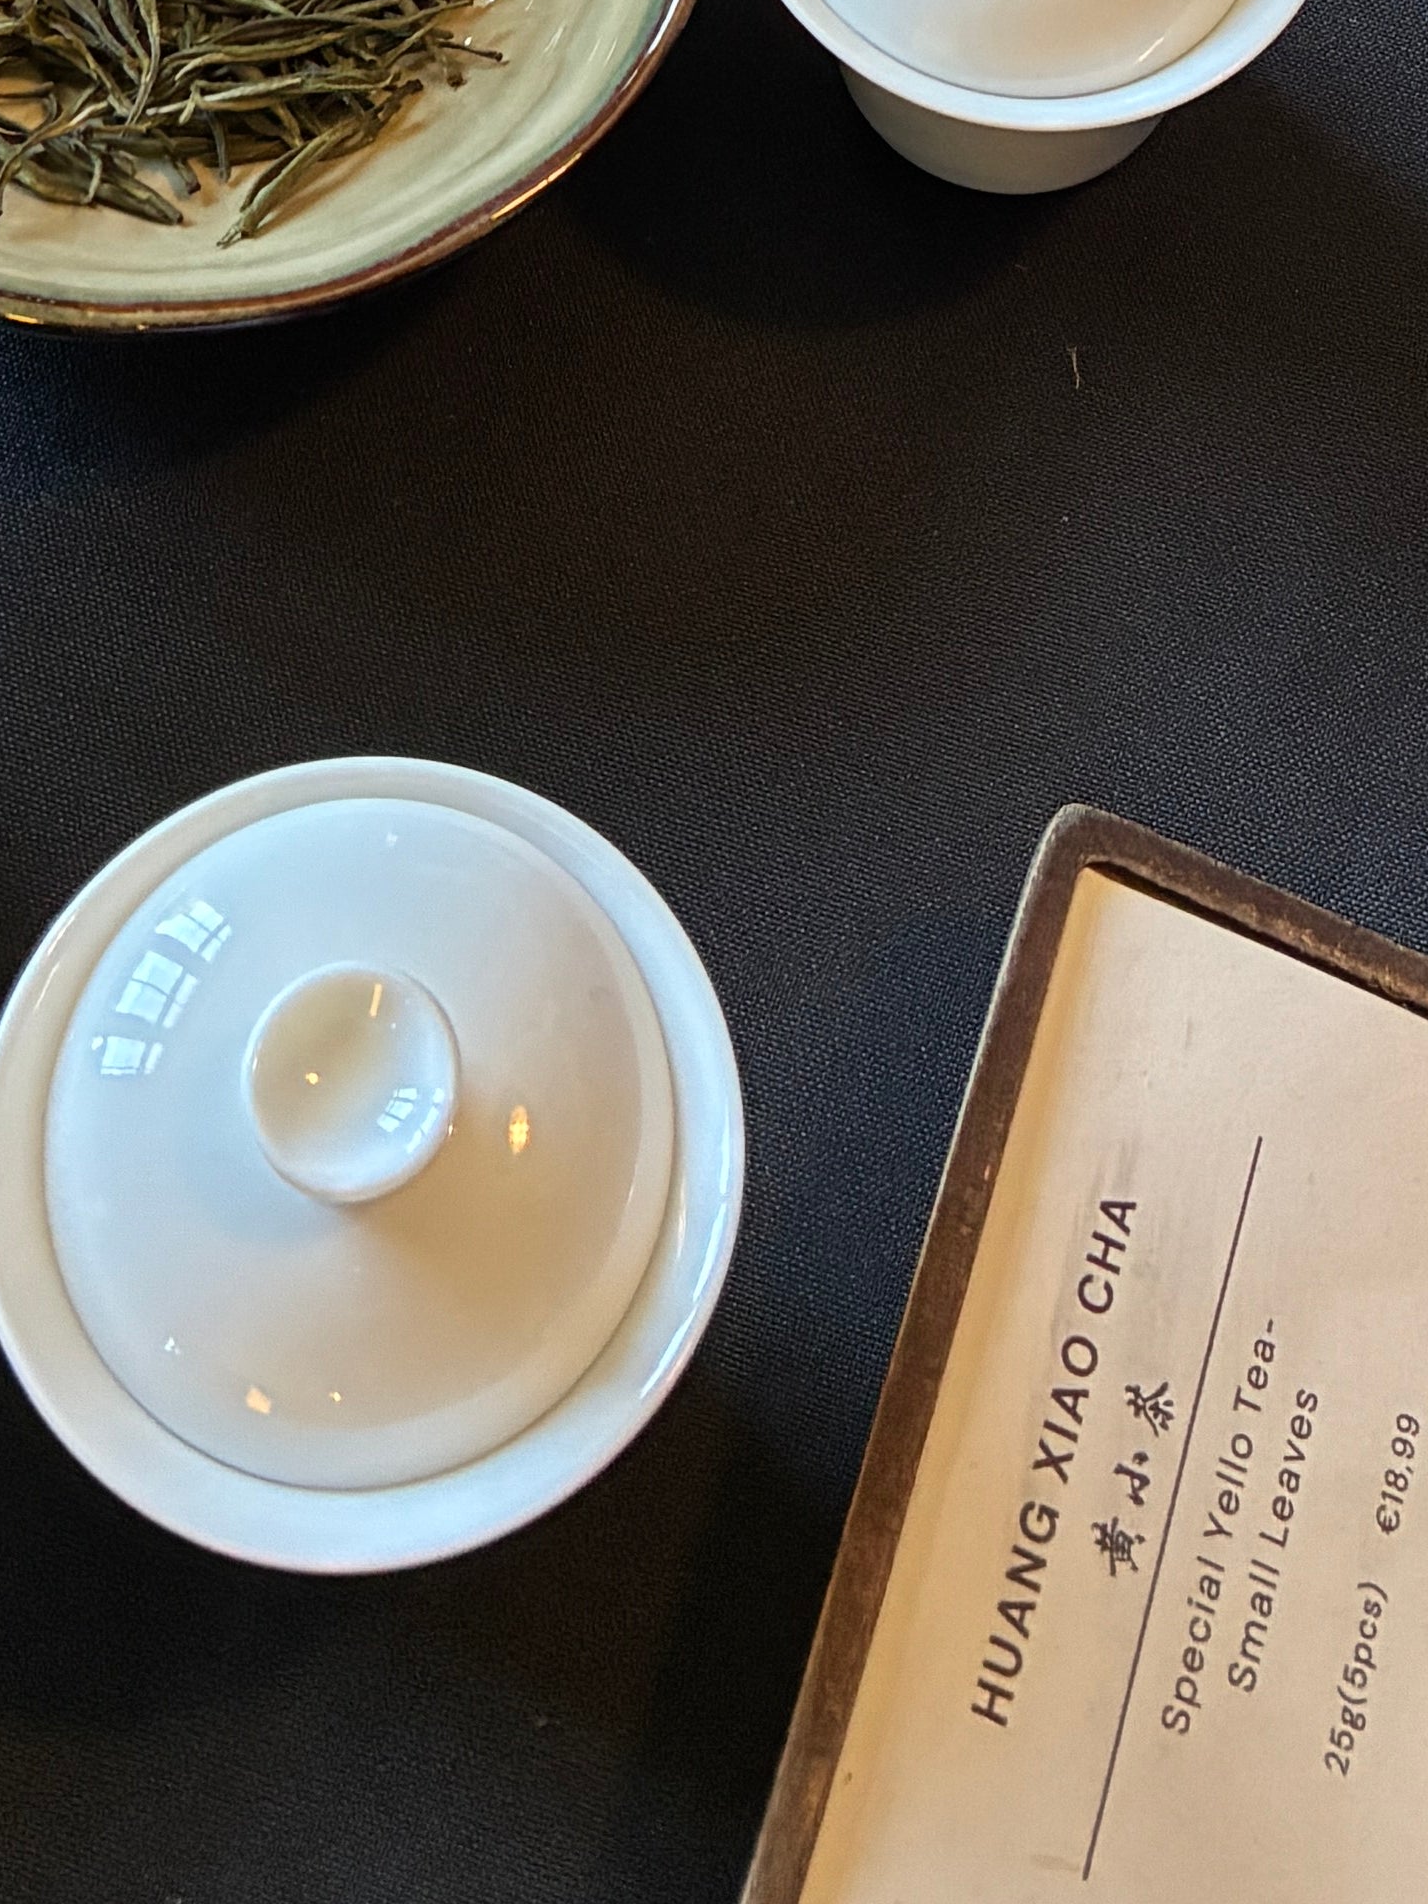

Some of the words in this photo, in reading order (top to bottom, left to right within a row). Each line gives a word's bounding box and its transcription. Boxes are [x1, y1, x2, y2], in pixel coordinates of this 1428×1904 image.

[969, 1499, 1060, 1726] HUANG
[1030, 1334, 1099, 1484] XIAO
[1075, 1199, 1137, 1315] CHA
[1090, 1381, 1174, 1577] 黄小茶
[1159, 1554, 1226, 1736] Special
[1201, 1432, 1254, 1538] Yello
[1231, 1318, 1276, 1413] Tea-
[1226, 1557, 1280, 1693] Small
[1257, 1388, 1318, 1549] Leaves
[1322, 1580, 1388, 1776] 25g(5pcs)
